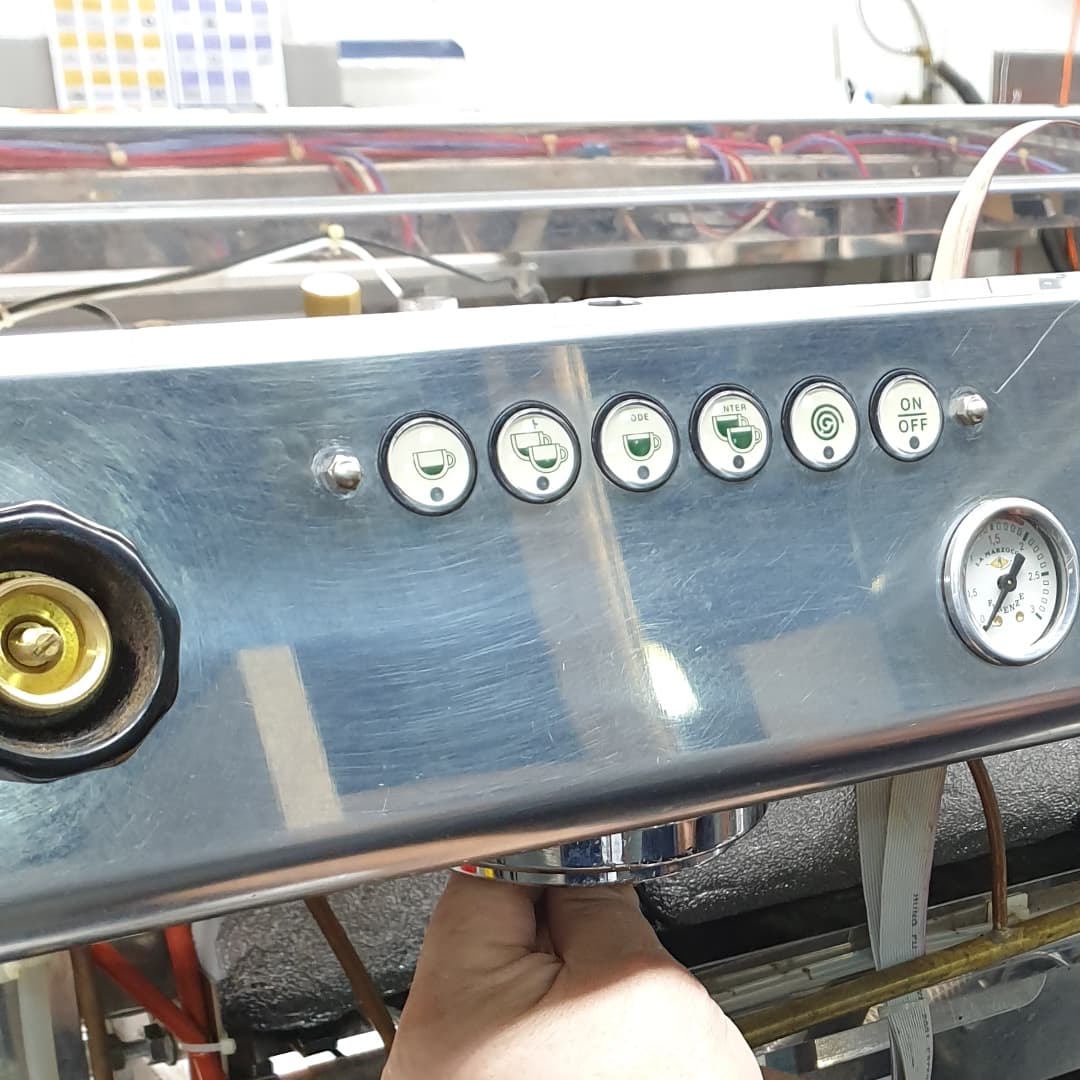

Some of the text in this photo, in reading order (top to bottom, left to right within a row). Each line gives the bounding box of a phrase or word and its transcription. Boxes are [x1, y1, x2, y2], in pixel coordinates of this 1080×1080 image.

[721, 403, 747, 413] NTER
[900, 397, 922, 411] ON
[898, 418, 928, 433] OFF
[985, 546, 1018, 557] MARZOCC
[1019, 542, 1025, 551] 2
[1028, 571, 1040, 581] 2,5
[987, 592, 1025, 614] FENZE
